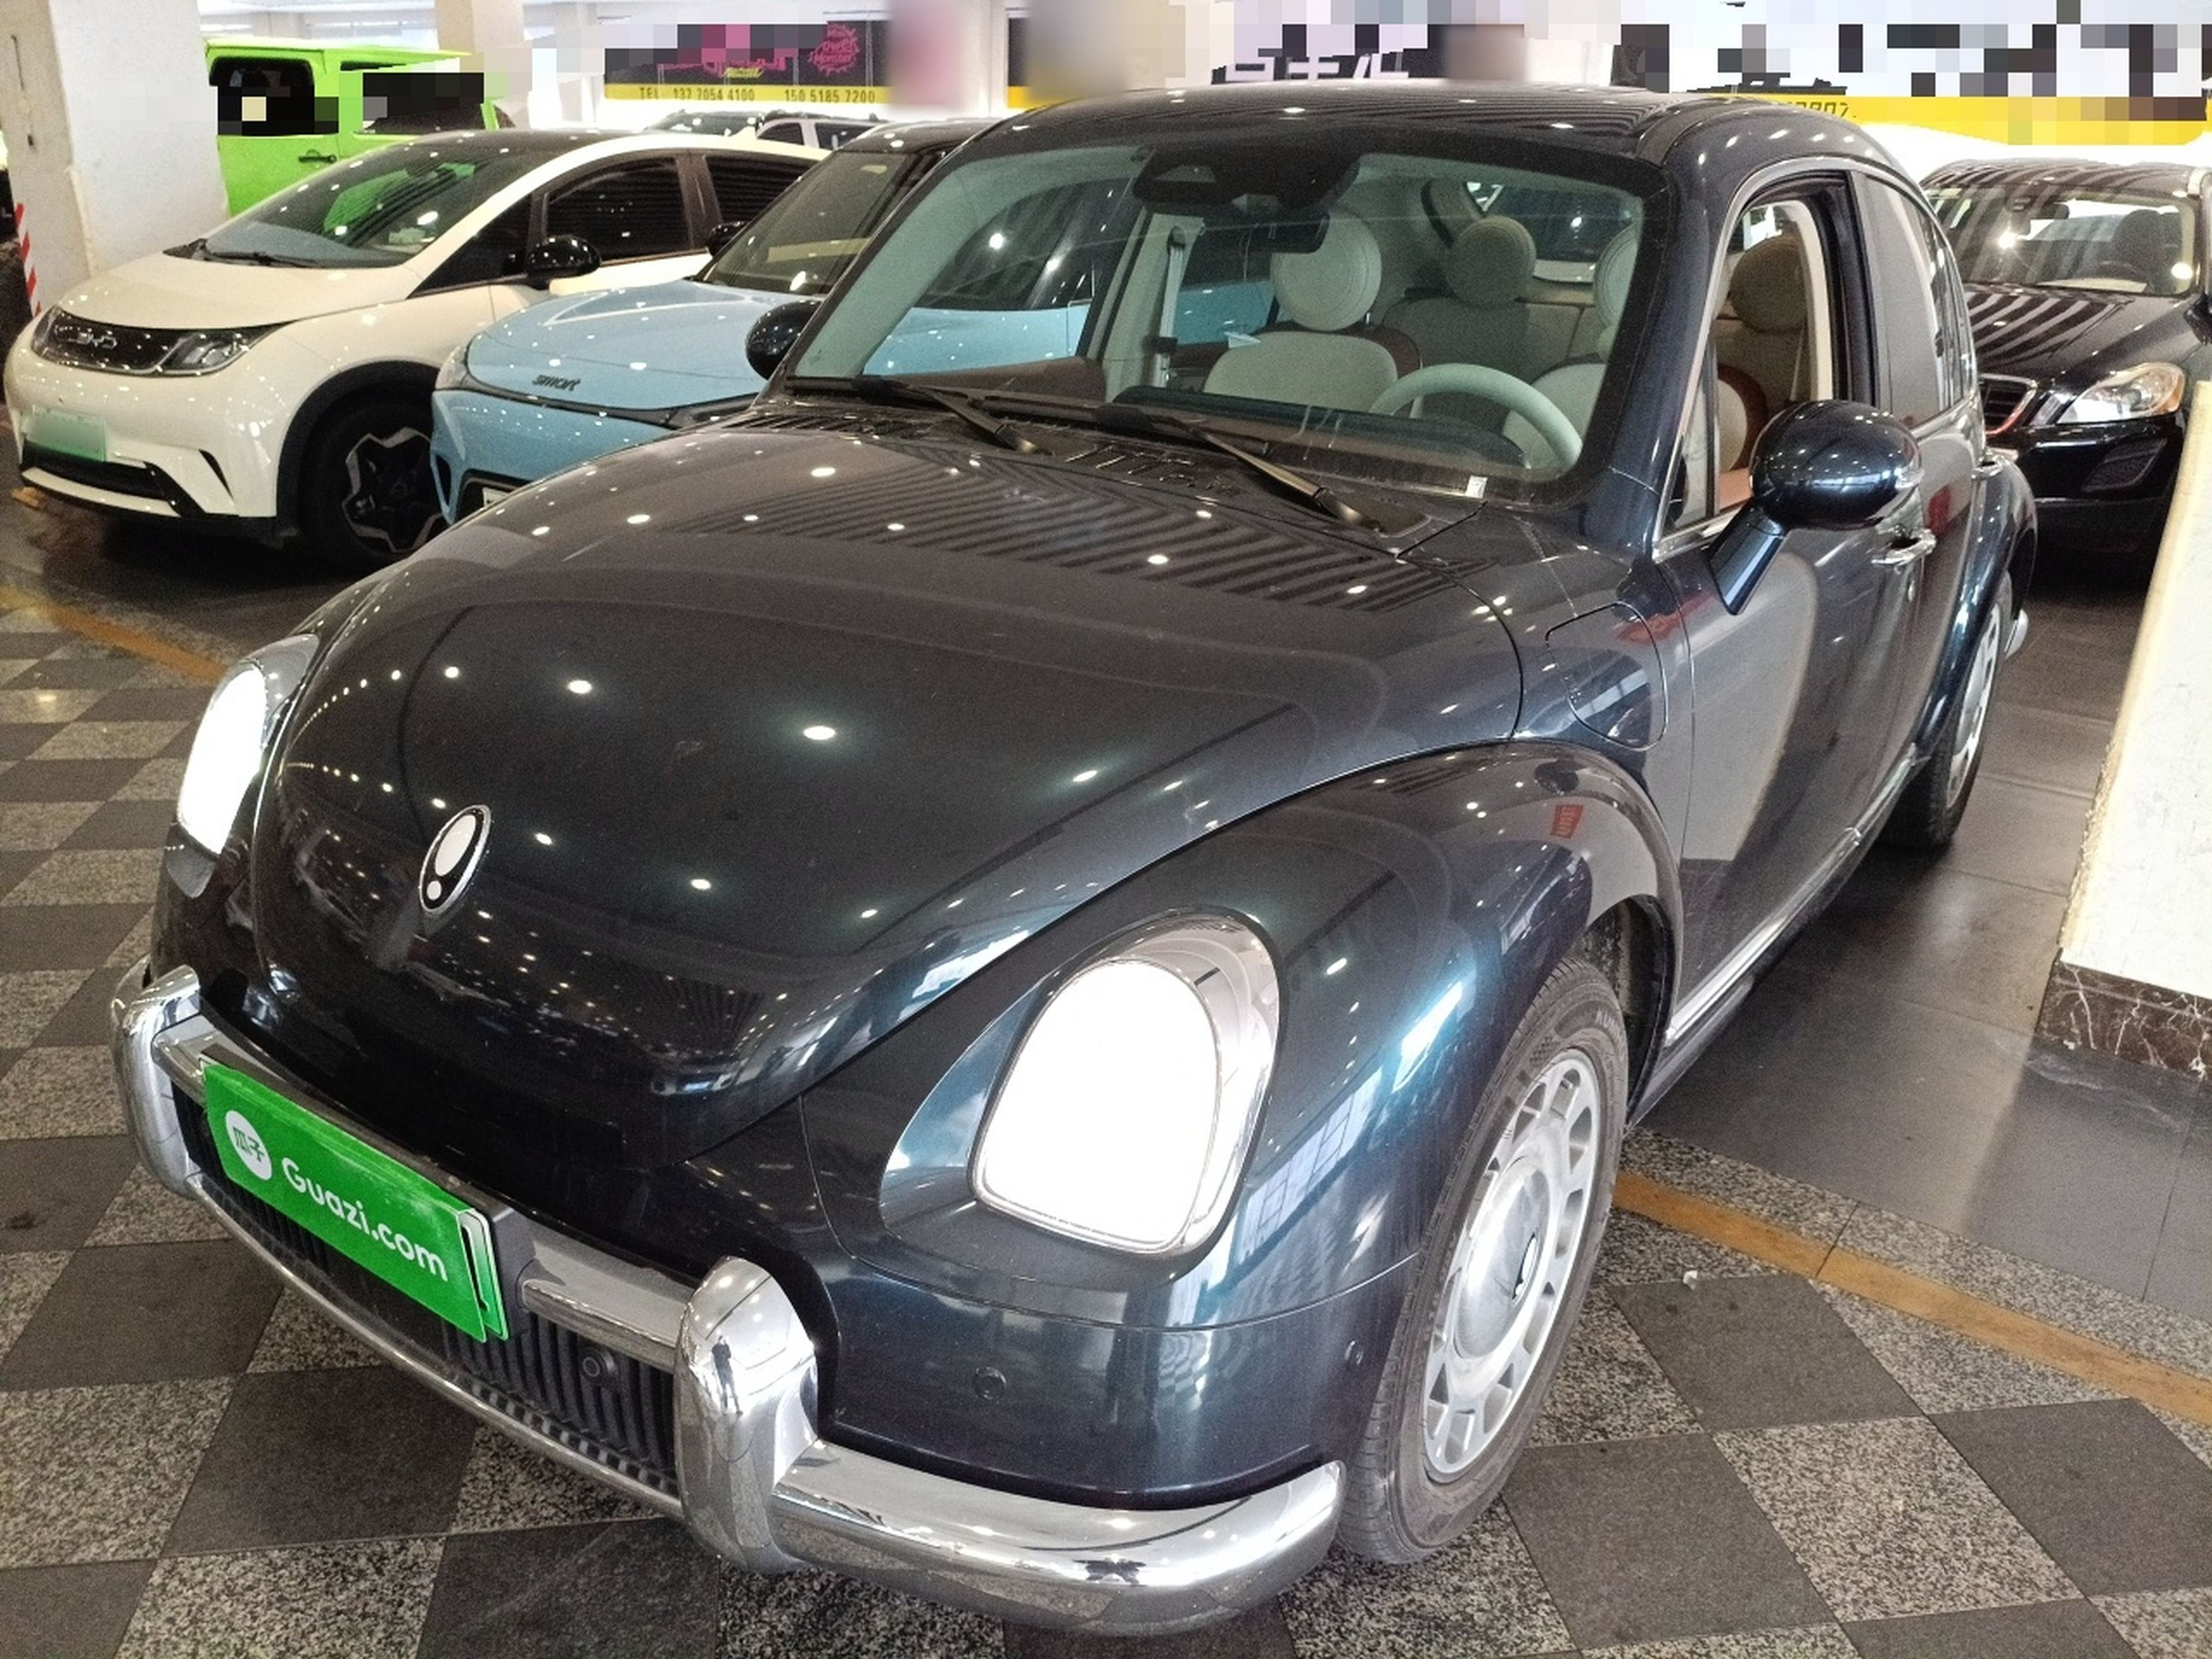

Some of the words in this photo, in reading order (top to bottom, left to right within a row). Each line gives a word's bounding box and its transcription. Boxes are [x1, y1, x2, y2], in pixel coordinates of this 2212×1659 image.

[640, 87, 659, 100] TEL
[673, 88, 691, 100] 137
[696, 88, 723, 101] 7054
[728, 88, 755, 101] 4100
[785, 89, 806, 103] 150
[810, 89, 839, 103] 5185
[846, 89, 875, 103] 7200
[532, 374, 581, 391] smart
[282, 1157, 448, 1282] Guazi.com
